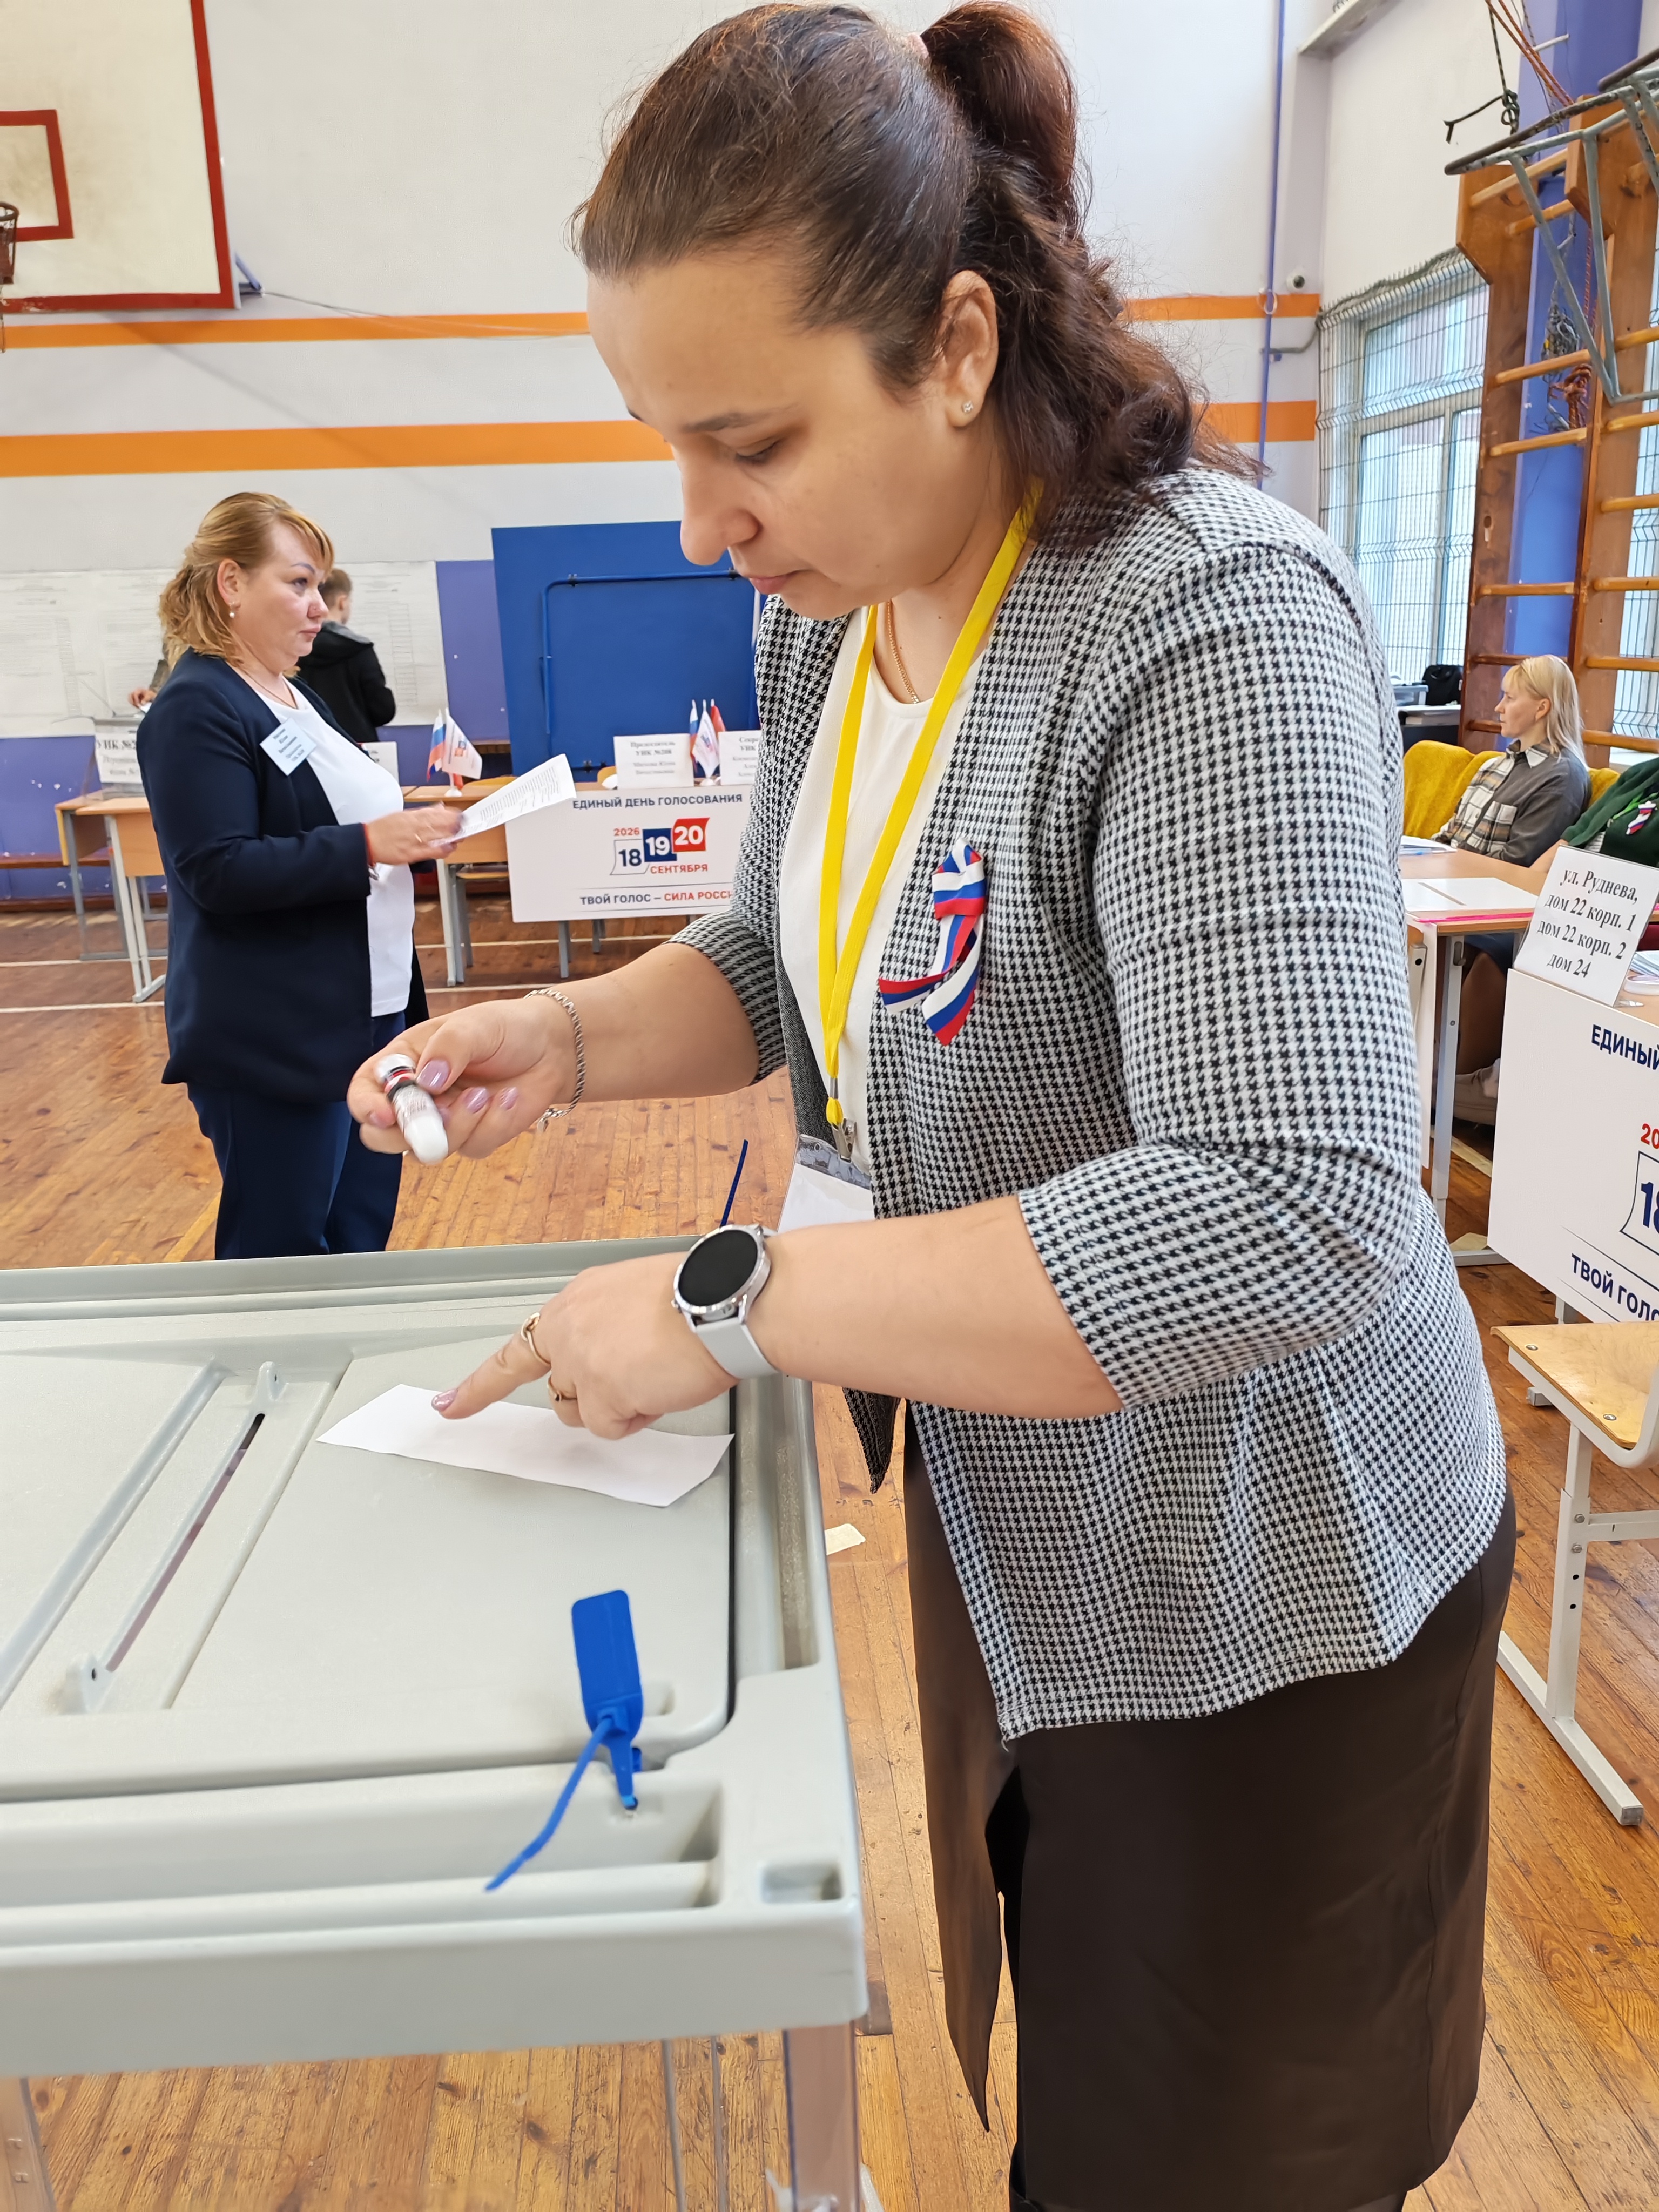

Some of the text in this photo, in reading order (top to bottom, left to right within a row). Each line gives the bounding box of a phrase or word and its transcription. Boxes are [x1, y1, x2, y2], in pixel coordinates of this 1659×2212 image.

[573, 794, 743, 810] ЕДИНЫЙ ДЕНЬ ГОЛОСОВАНИЯ
[613, 827, 640, 837] 2026
[618, 825, 703, 867] 18 19 20
[650, 864, 708, 874] СЕНТЯБРЯ
[579, 893, 611, 905] ТВОЙ
[614, 894, 651, 904] ГОЛОС
[664, 891, 695, 902] СИЛА
[1559, 869, 1638, 905] ул. Руднева,
[1544, 894, 1636, 932] дом 22 корп. 1
[1537, 920, 1627, 960] дом 22 корп. 2
[1547, 954, 1591, 978] дом 24
[1572, 1253, 1613, 1299] ТВОЙ
